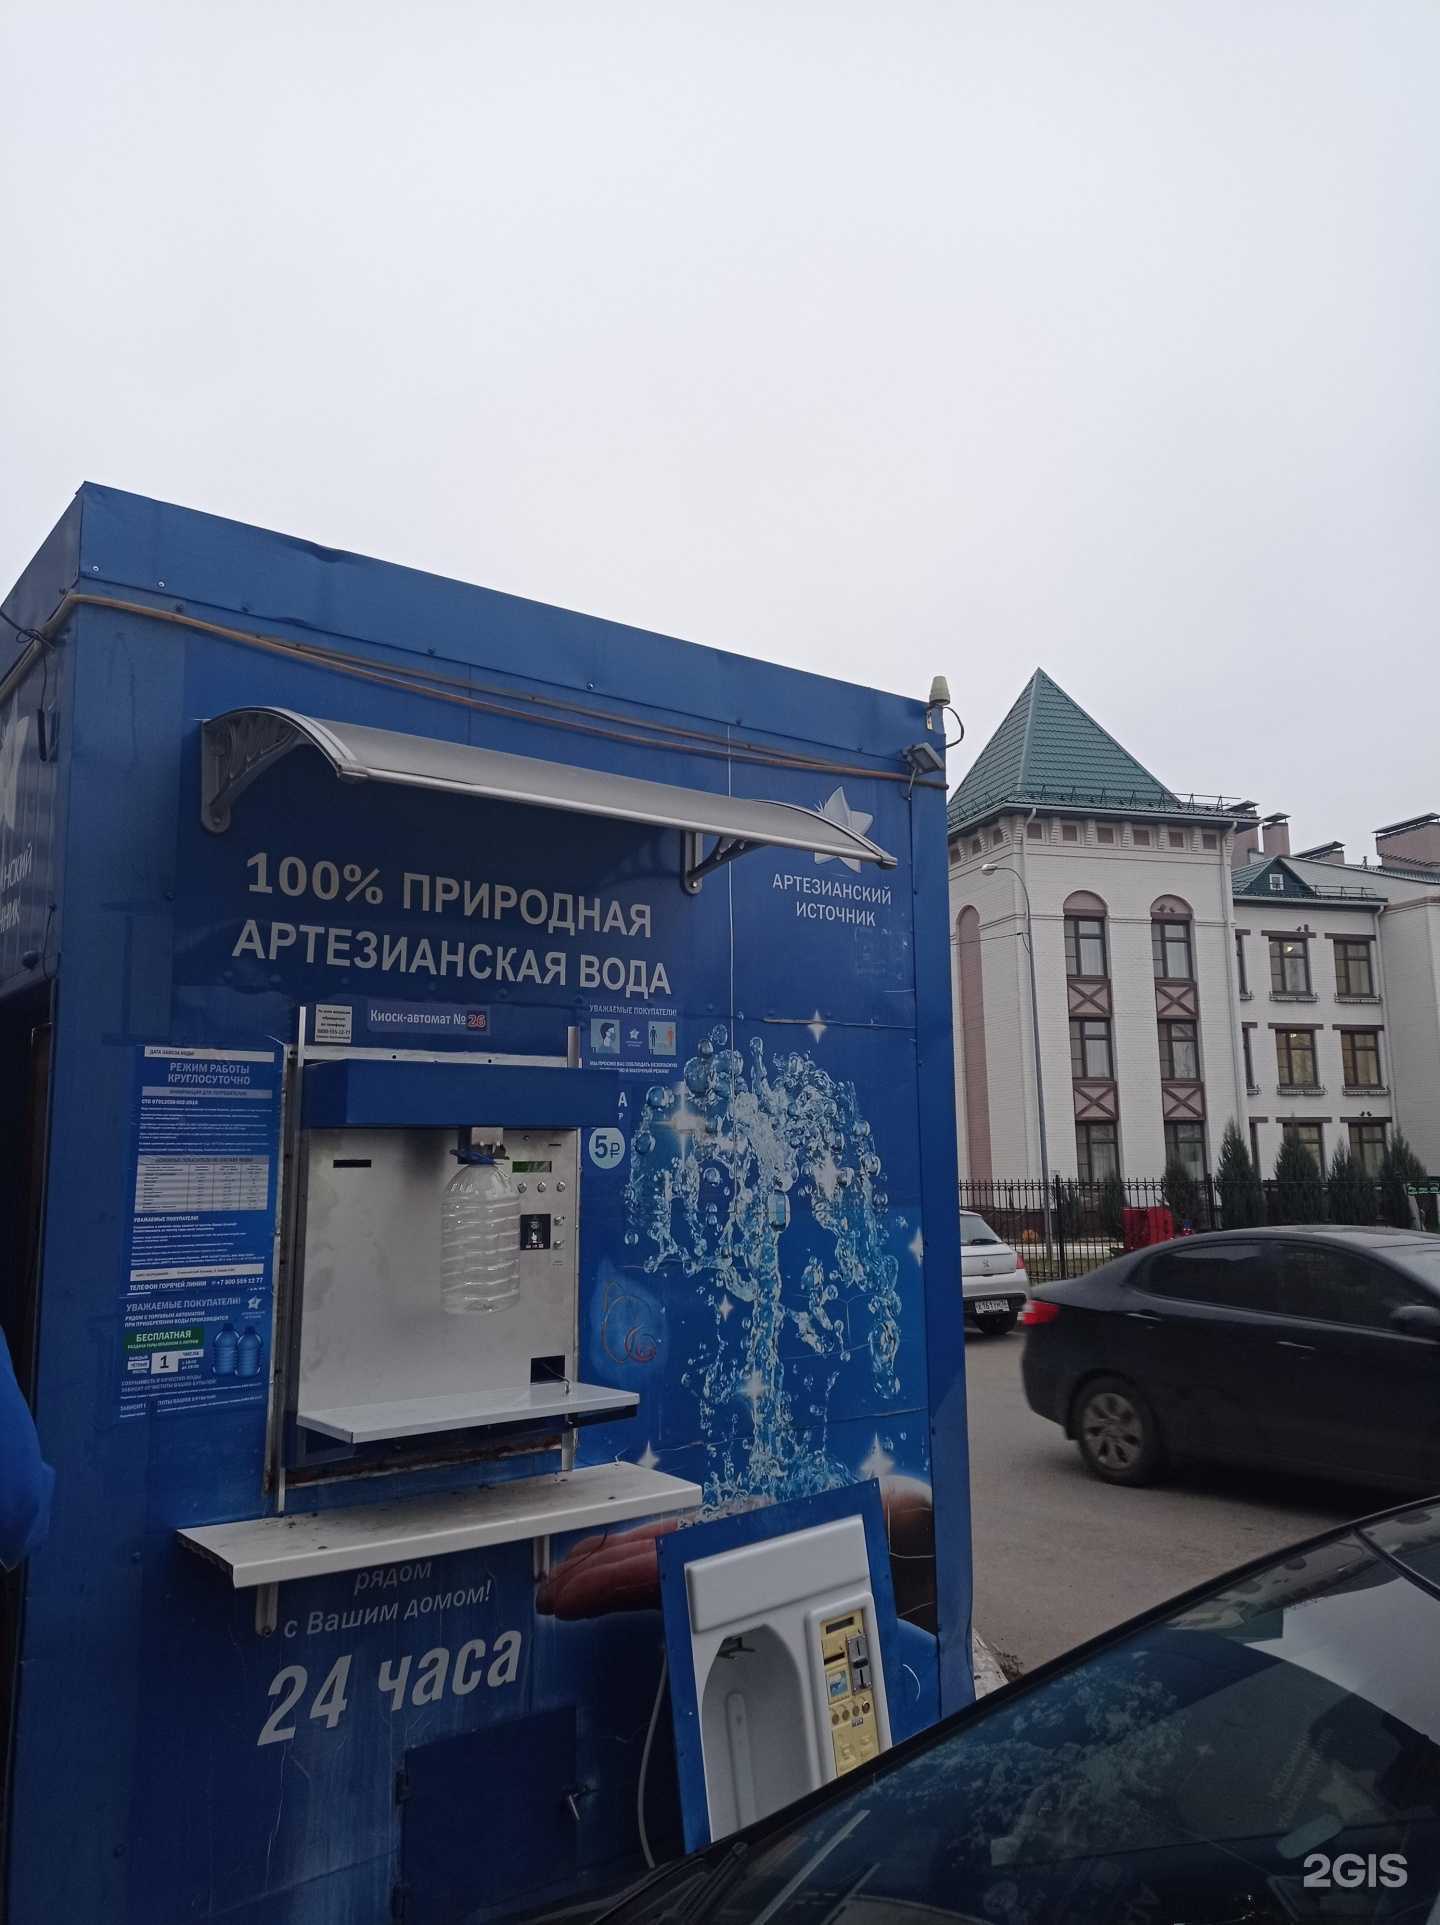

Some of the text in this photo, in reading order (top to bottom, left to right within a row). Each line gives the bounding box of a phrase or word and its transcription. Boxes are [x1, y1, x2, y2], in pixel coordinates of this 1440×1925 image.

[246, 852, 652, 938] 100% ПРИРОДНАЯ
[772, 873, 892, 905] АРТЕЗИАНСКИЙ
[796, 901, 876, 927] ИСТОЧНИК
[231, 918, 672, 1000] АРТЕЗИАНСКАЯ ВОДА
[370, 1009, 486, 1028] Киоск-автомат № 26
[590, 1005, 632, 1015] УВАЖАЕМЫЕ
[169, 1062, 250, 1074] РЕЖИМ РАБОТЫ
[167, 1073, 250, 1086] КРУГЛОСУТОЧНО
[129, 1283, 158, 1291] ТЕЛЕФОН
[126, 1297, 241, 1313] УВАЖАЕМЫЕ ПОКУПАТЕЛИ!
[136, 1330, 191, 1342] БЕСПЛАТНАЯ
[160, 1355, 169, 1369] 1
[353, 1560, 433, 1597] рядом
[283, 1578, 494, 1639] с Вашим домом!
[257, 1629, 523, 1748] 24 часа
